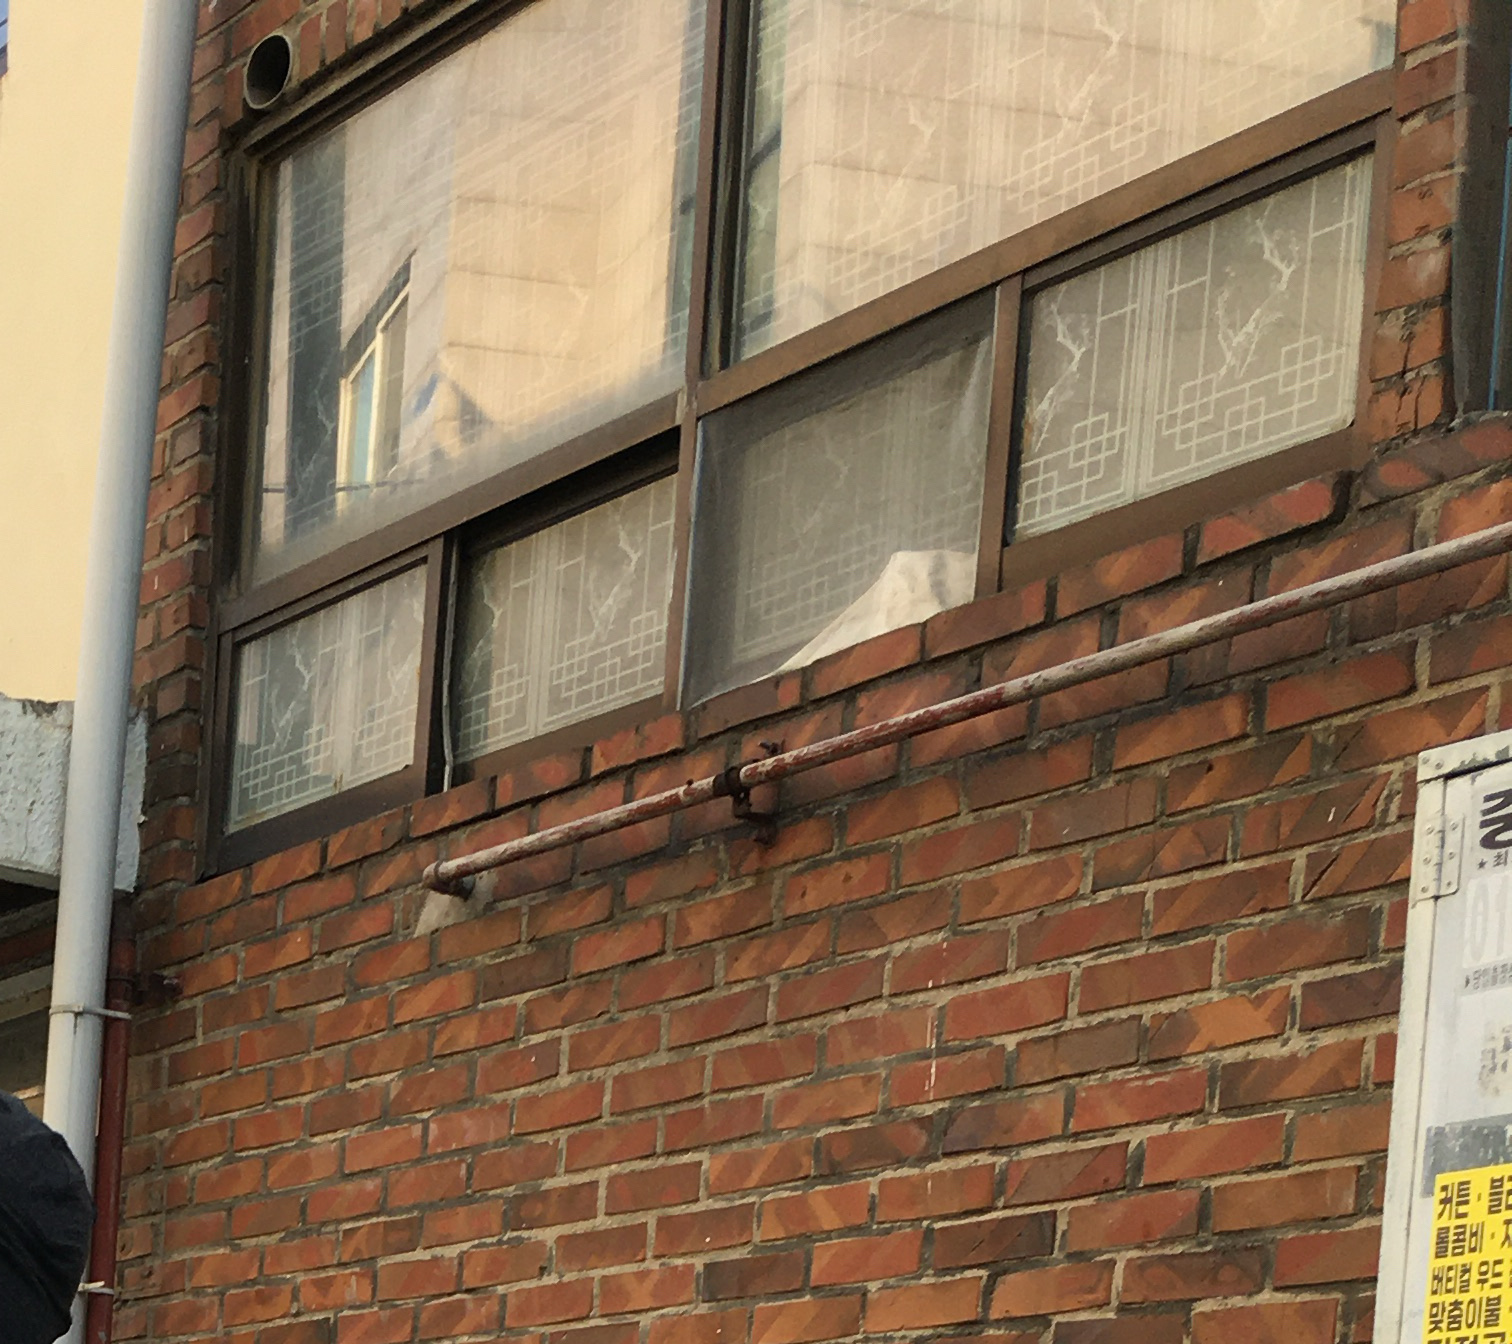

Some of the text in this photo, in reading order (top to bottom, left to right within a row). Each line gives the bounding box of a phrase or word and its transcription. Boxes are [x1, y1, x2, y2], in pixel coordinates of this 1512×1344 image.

[1438, 1180, 1471, 1220] 커튼
[1434, 1221, 1485, 1259] 롤콤비
[1431, 1259, 1503, 1295] 버티컬 우드
[1428, 1295, 1502, 1334] 맞춤이불
